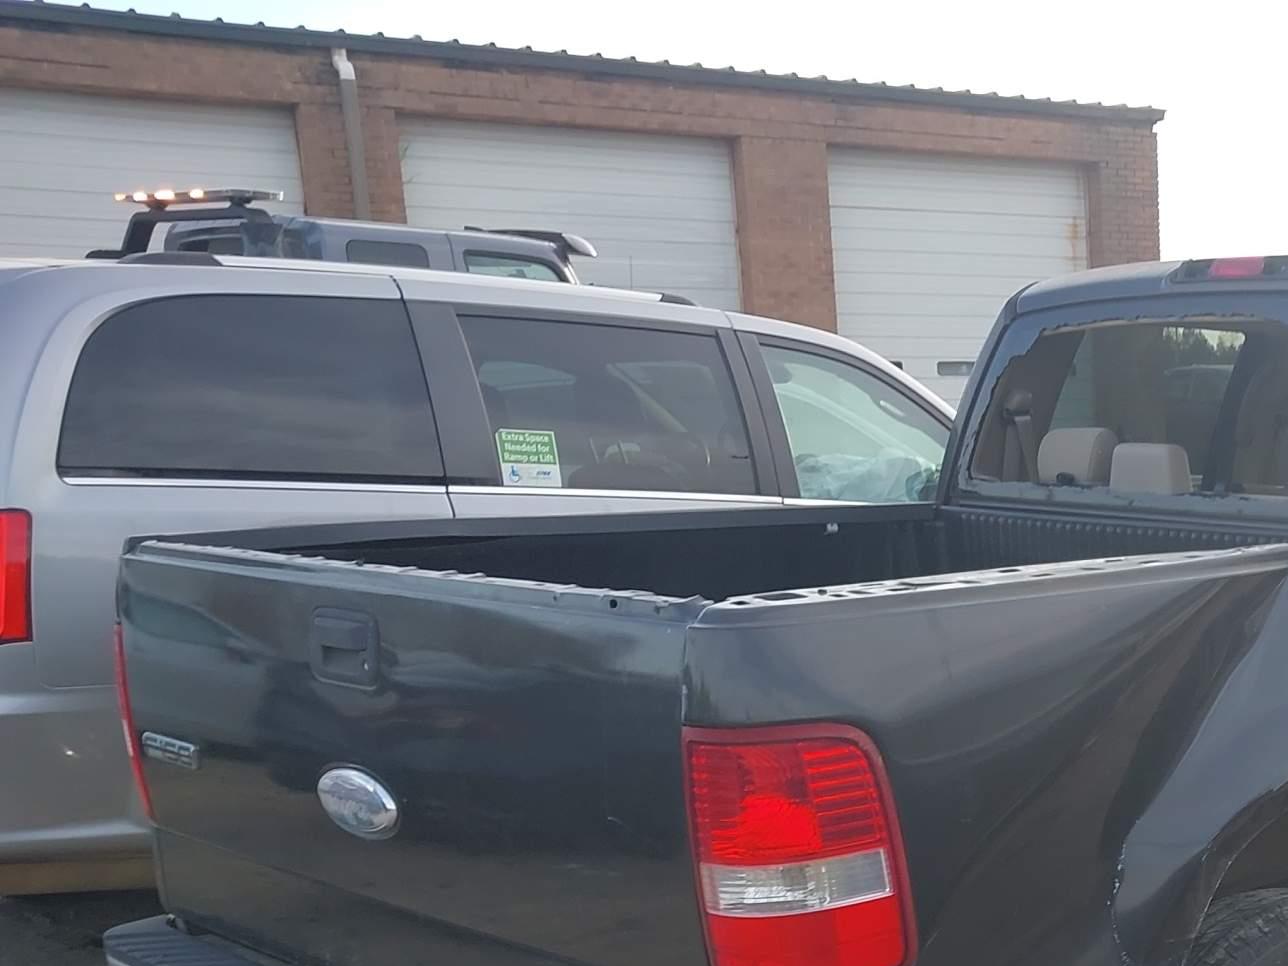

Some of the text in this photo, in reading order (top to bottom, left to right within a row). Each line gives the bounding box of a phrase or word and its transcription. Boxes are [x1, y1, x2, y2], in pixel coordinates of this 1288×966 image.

[501, 431, 549, 443] Extra Space
[504, 442, 550, 453] Needed for
[504, 452, 528, 463] Ramp
[540, 453, 554, 463] Lift
